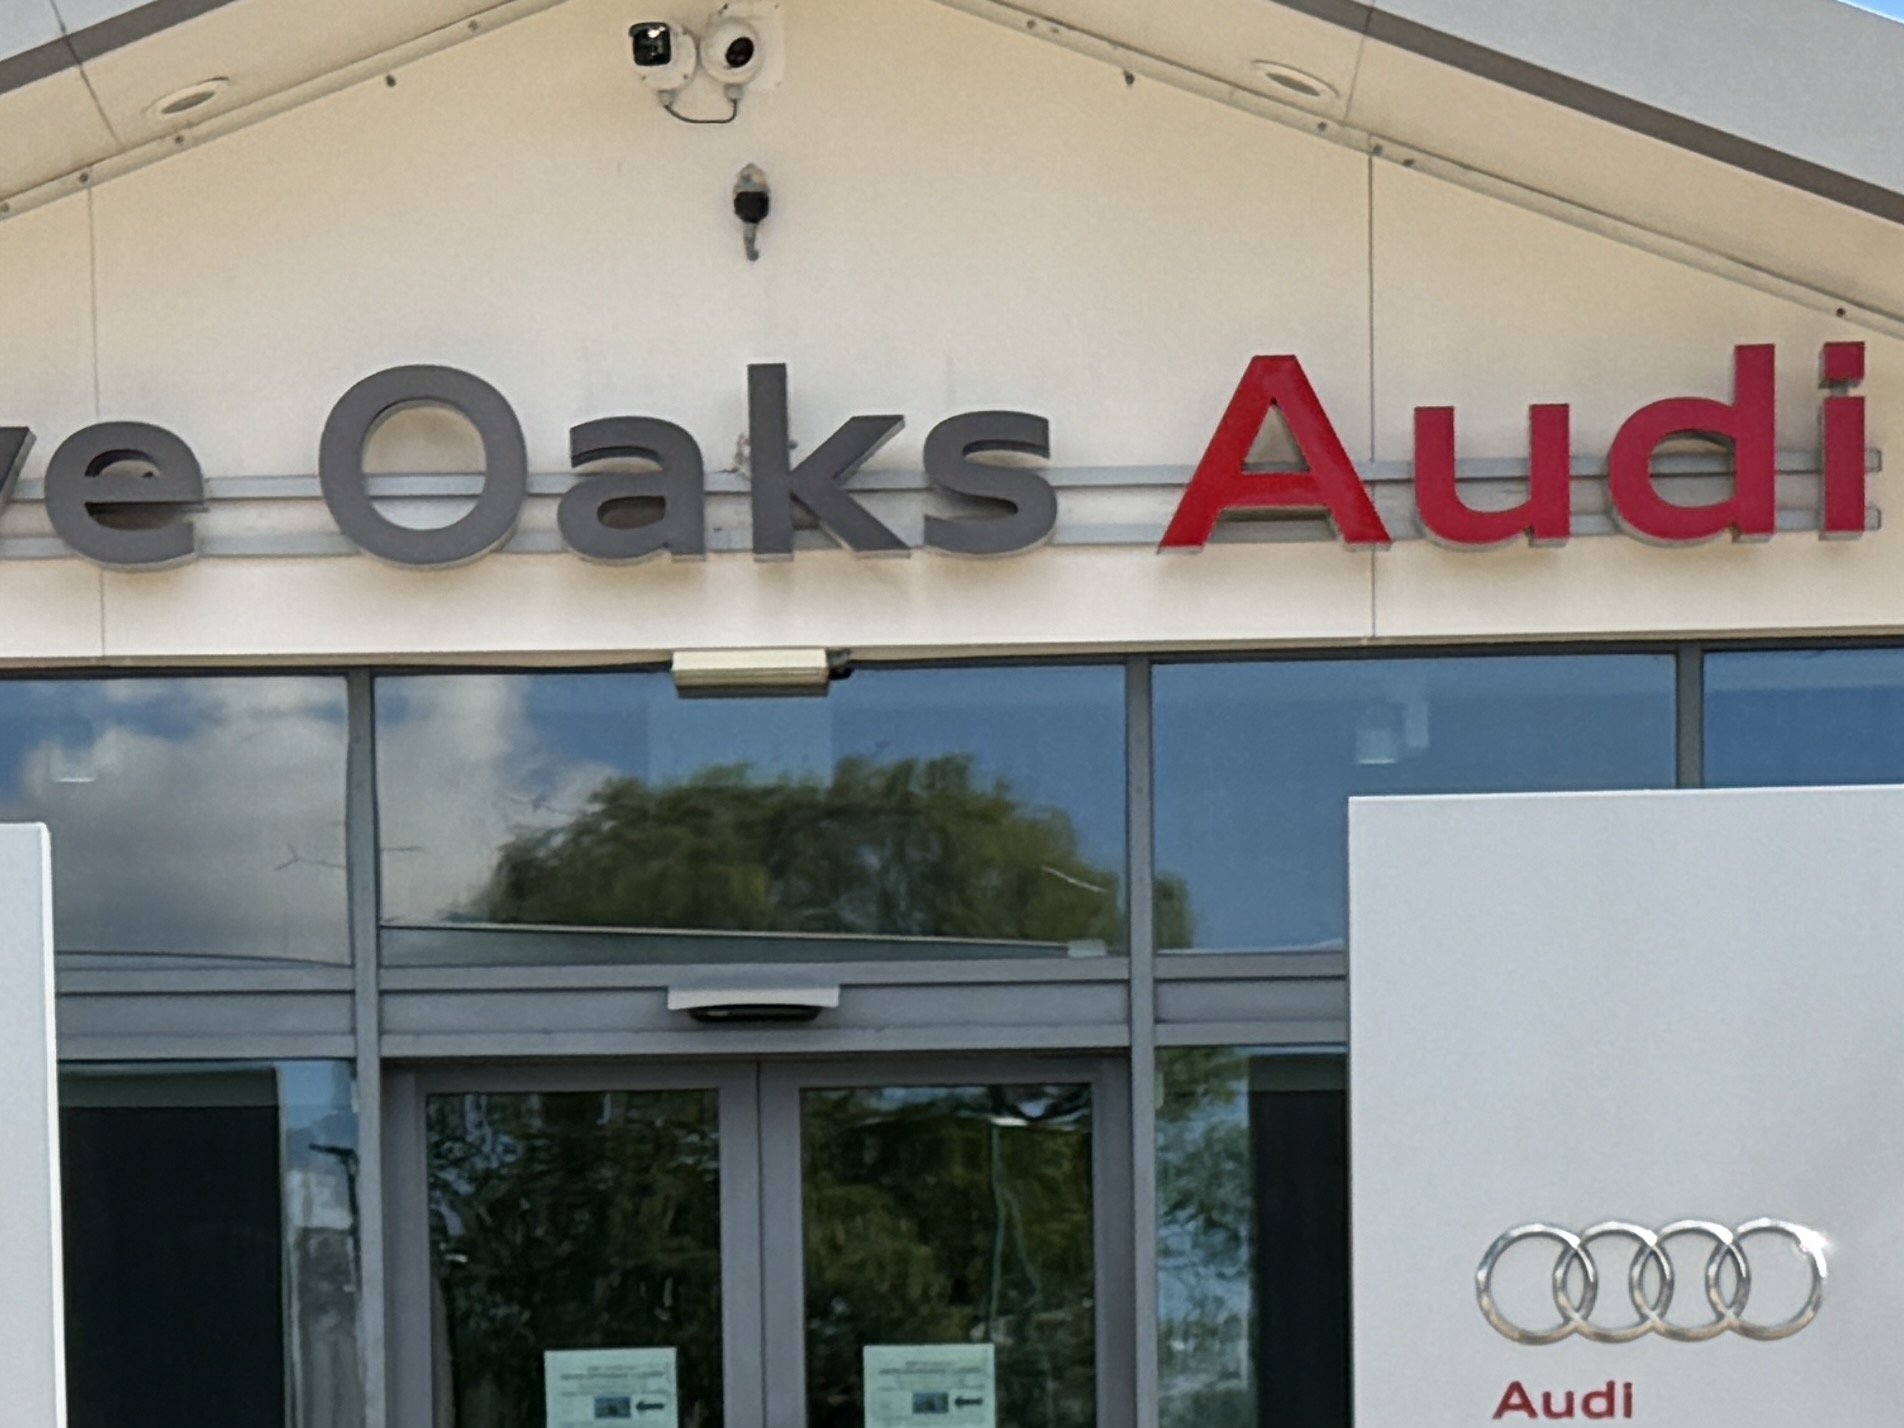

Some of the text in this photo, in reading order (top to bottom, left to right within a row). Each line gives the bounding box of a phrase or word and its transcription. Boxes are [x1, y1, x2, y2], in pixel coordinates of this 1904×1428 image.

[319, 362, 1058, 570] Oaks
[1157, 340, 1866, 554] Audi
[1492, 1380, 1633, 1419] Audi
